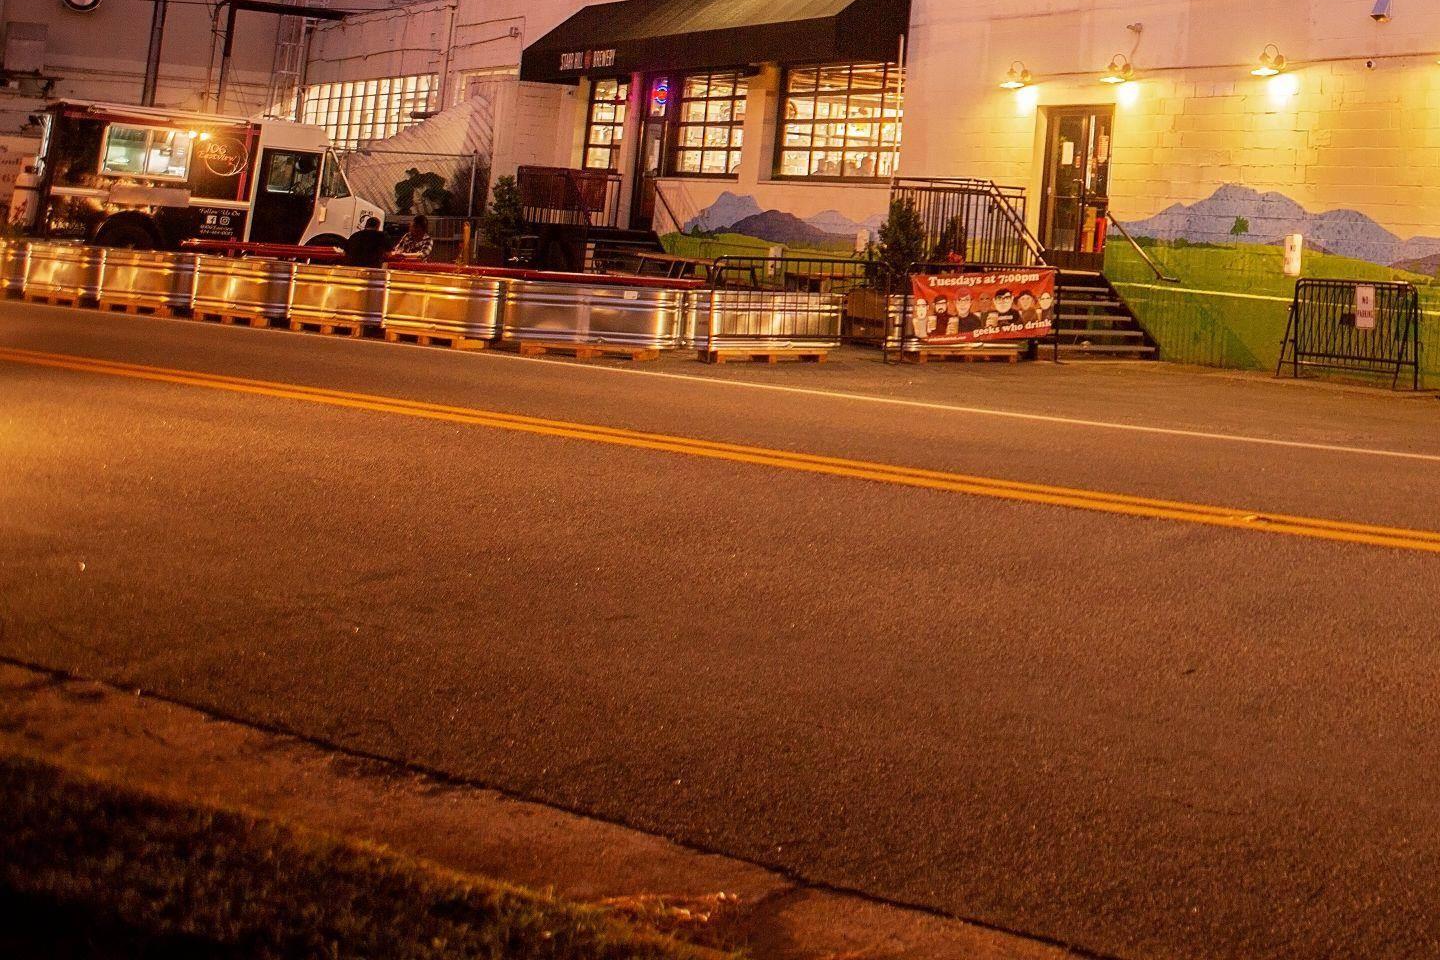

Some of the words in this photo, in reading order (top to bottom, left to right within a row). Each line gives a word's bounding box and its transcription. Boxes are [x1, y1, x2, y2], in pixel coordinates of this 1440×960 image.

[592, 50, 616, 67] BREWERY
[928, 275, 982, 287] Tuesdays
[984, 274, 996, 285] at
[999, 272, 1040, 285] 7:00pm
[1362, 296, 1369, 305] NO
[972, 325, 1000, 338] geeks
[1002, 322, 1023, 333] who
[1025, 318, 1052, 330] drink
